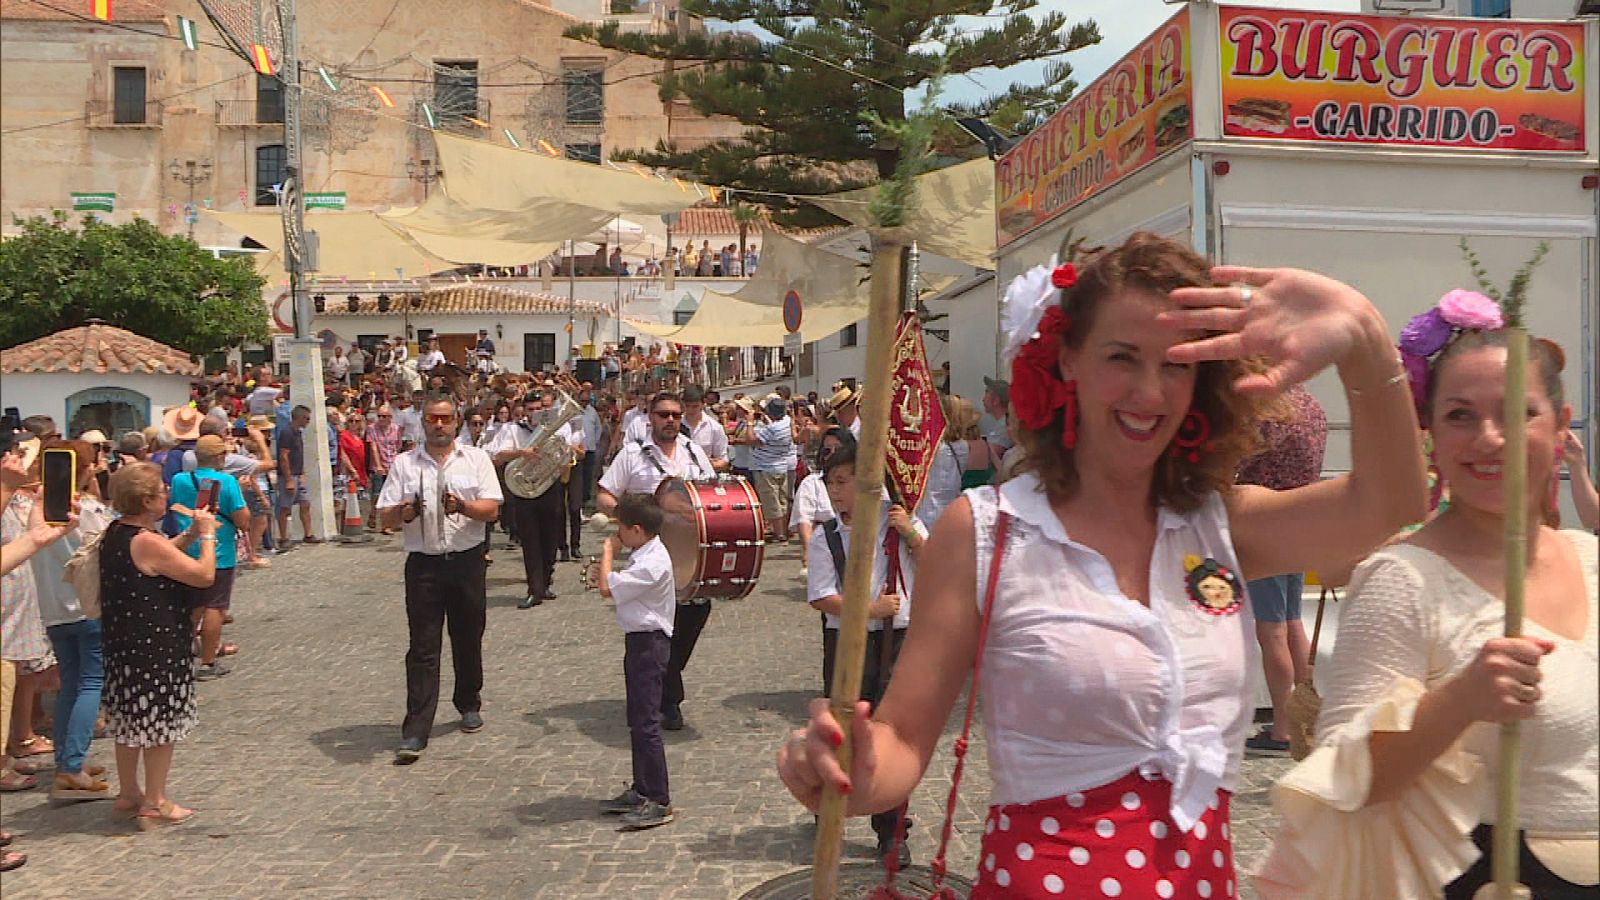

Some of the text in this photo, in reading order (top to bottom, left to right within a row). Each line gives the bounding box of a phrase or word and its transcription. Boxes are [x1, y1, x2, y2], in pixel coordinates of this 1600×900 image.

[1227, 16, 1576, 98] BURGUER
[1000, 25, 1186, 200] BAGUETERIA
[1295, 102, 1515, 144] -GARRIDO-
